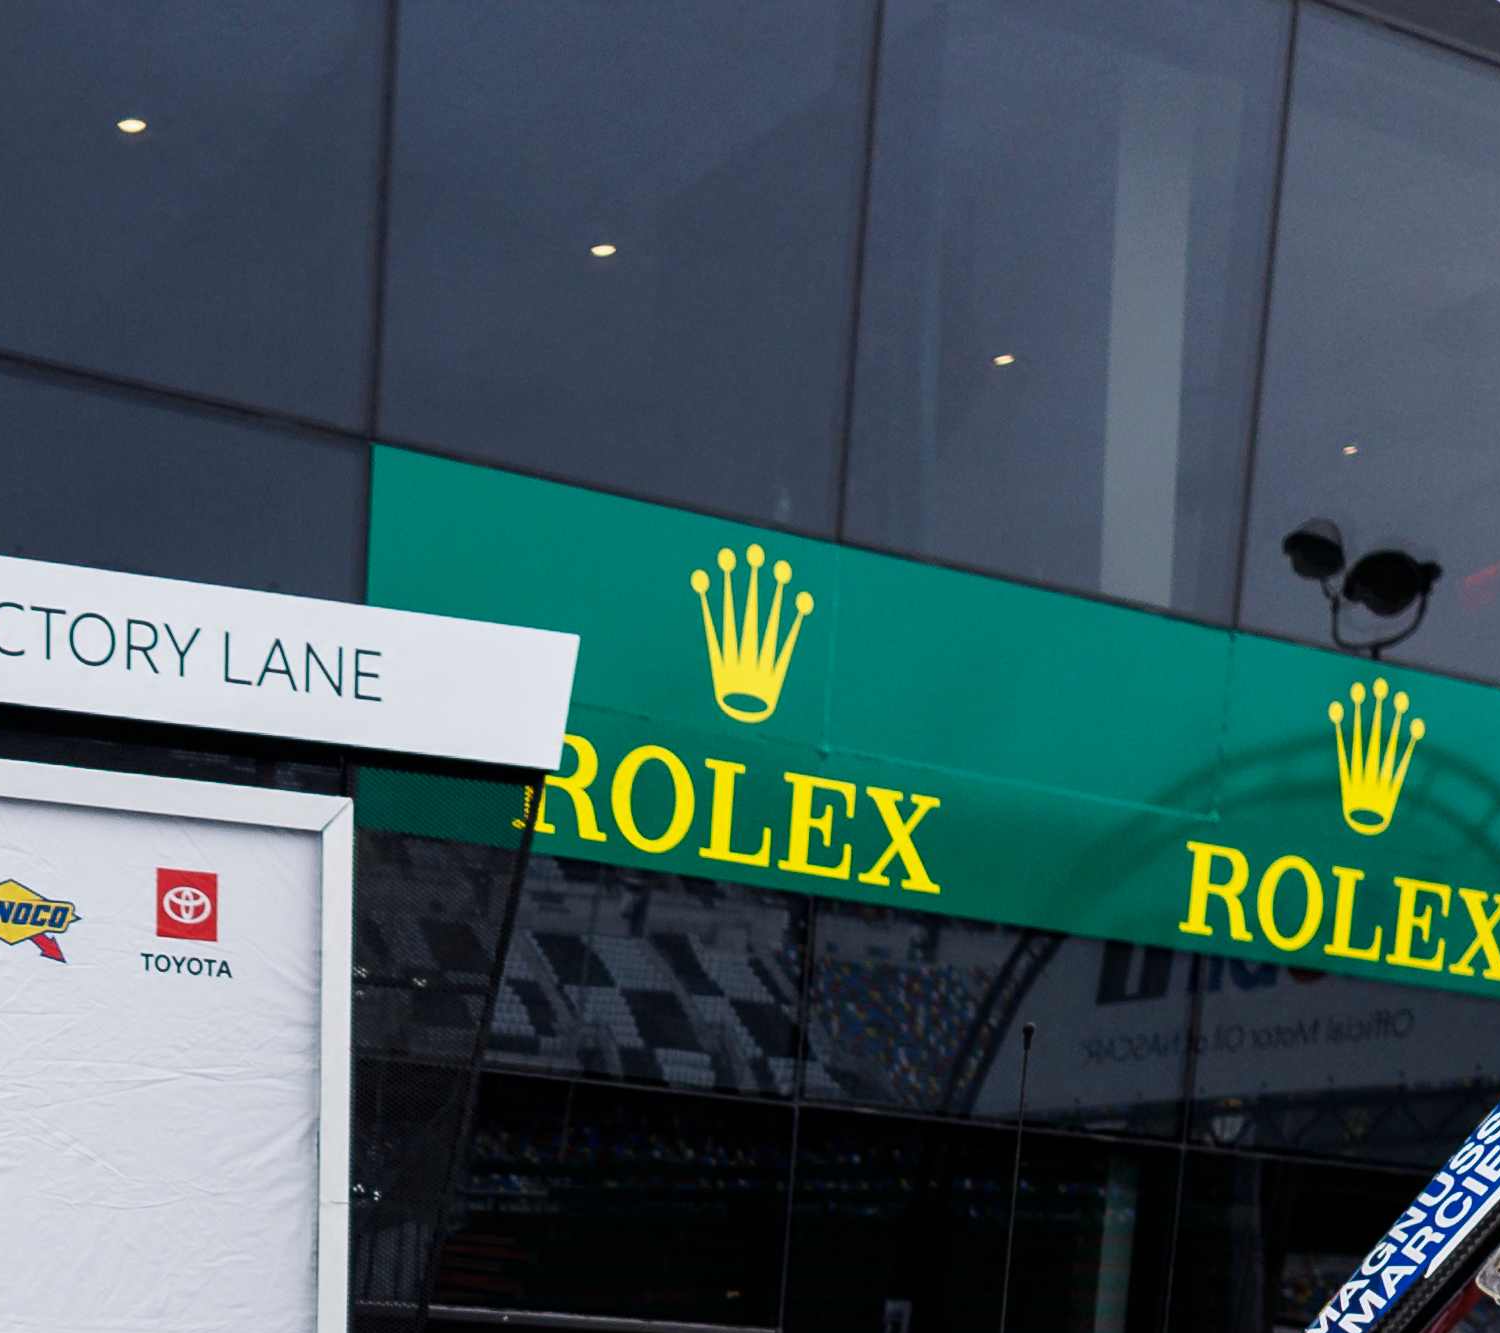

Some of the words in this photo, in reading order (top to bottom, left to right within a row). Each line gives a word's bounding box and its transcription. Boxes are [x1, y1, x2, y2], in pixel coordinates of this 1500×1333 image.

[222, 633, 385, 704] LANE
[533, 733, 941, 895] ROLEX
[141, 952, 233, 979] TOYOTA
